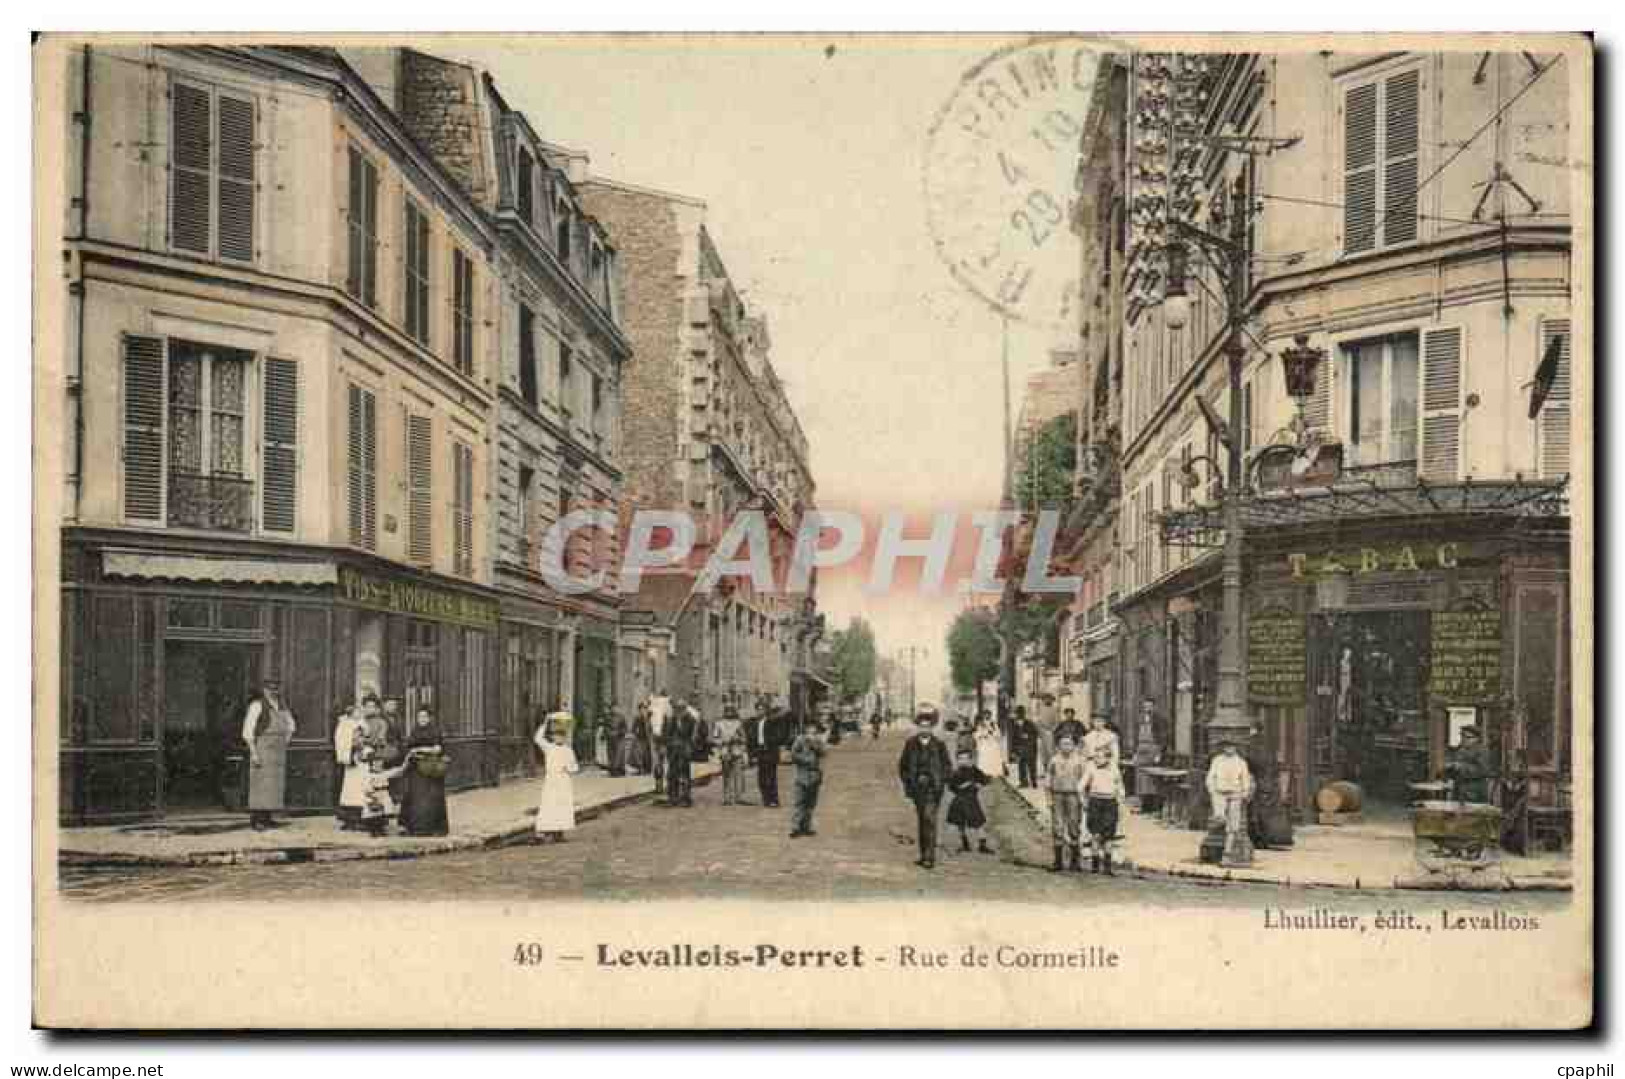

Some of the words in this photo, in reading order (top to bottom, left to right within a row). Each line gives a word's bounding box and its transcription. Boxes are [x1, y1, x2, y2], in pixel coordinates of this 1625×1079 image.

[1263, 908, 1366, 933] Lhuillier,
[1441, 909, 1540, 931] Levallois
[513, 943, 543, 966] 49
[596, 943, 863, 968] Levallois-Perret
[899, 945, 949, 968] Rue
[960, 945, 989, 968] de
[996, 945, 1120, 968] Cormeille
